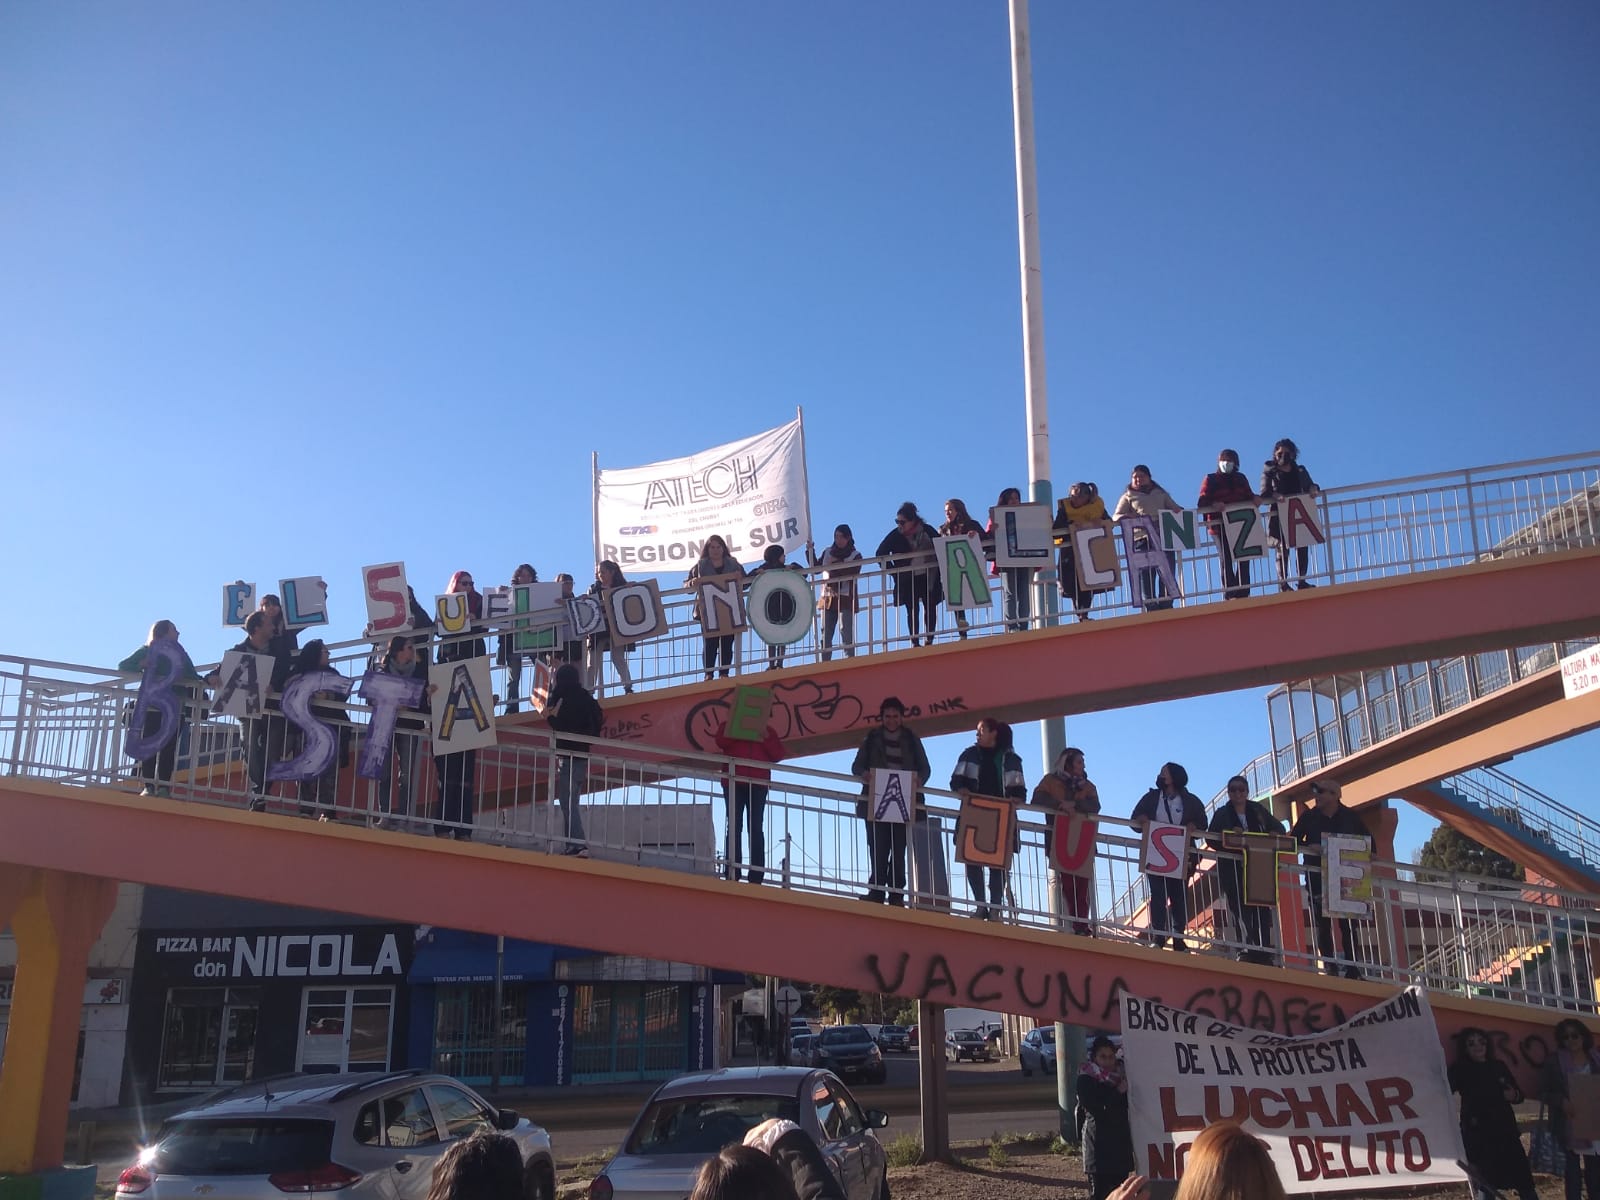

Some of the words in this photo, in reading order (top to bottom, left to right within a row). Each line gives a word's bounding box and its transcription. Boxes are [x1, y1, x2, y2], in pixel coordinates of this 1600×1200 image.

[643, 455, 759, 510] ATECH
[753, 496, 789, 517] CTERA
[603, 534, 742, 564] REGIONL
[749, 517, 799, 548] SUR
[619, 525, 655, 536] CTA
[1563, 658, 1588, 678] ALTURA
[1590, 651, 1600, 668] MA
[928, 696, 969, 715] INK
[156, 938, 198, 953] PIZZA
[202, 937, 232, 953] BAR
[193, 957, 226, 978] don
[231, 934, 402, 977] NICOLA
[1127, 998, 1198, 1035] BASTA
[1207, 1022, 1243, 1039] DE
[1175, 1042, 1204, 1075] DE
[1211, 1045, 1241, 1076] LA
[1248, 1038, 1367, 1077] PROTESTA
[1160, 1077, 1419, 1132] LUCHAR
[1289, 1128, 1431, 1182] DELITO
